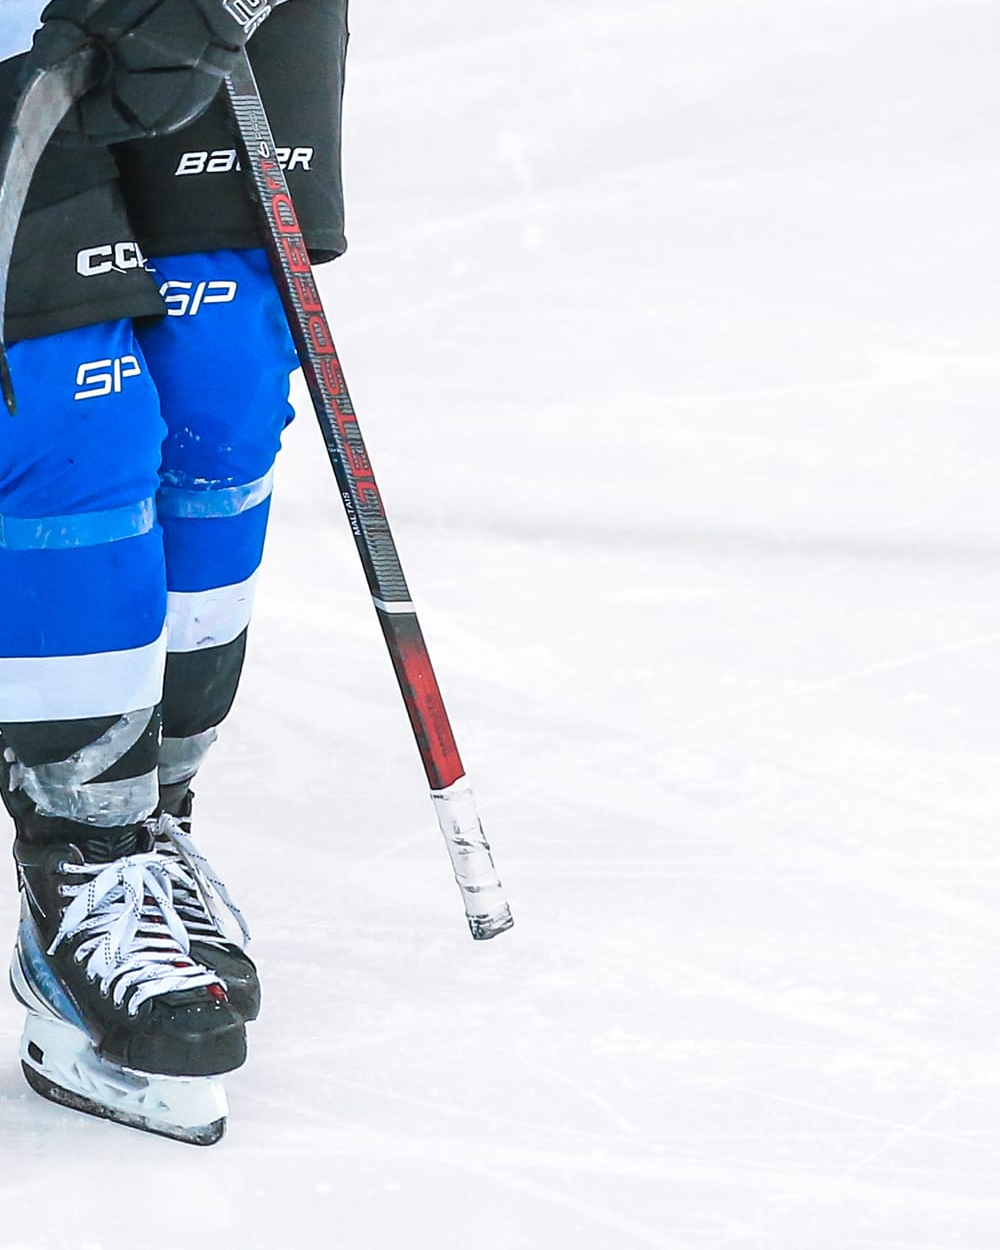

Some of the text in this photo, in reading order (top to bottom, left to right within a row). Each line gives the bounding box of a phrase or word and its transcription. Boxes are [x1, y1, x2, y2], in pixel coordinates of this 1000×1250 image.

[175, 147, 313, 176] BAER
[77, 241, 156, 276] CC
[159, 280, 237, 317] SP
[271, 194, 386, 518] JETSPEED
[74, 355, 142, 400] SP
[343, 492, 362, 536] MALTAIS
